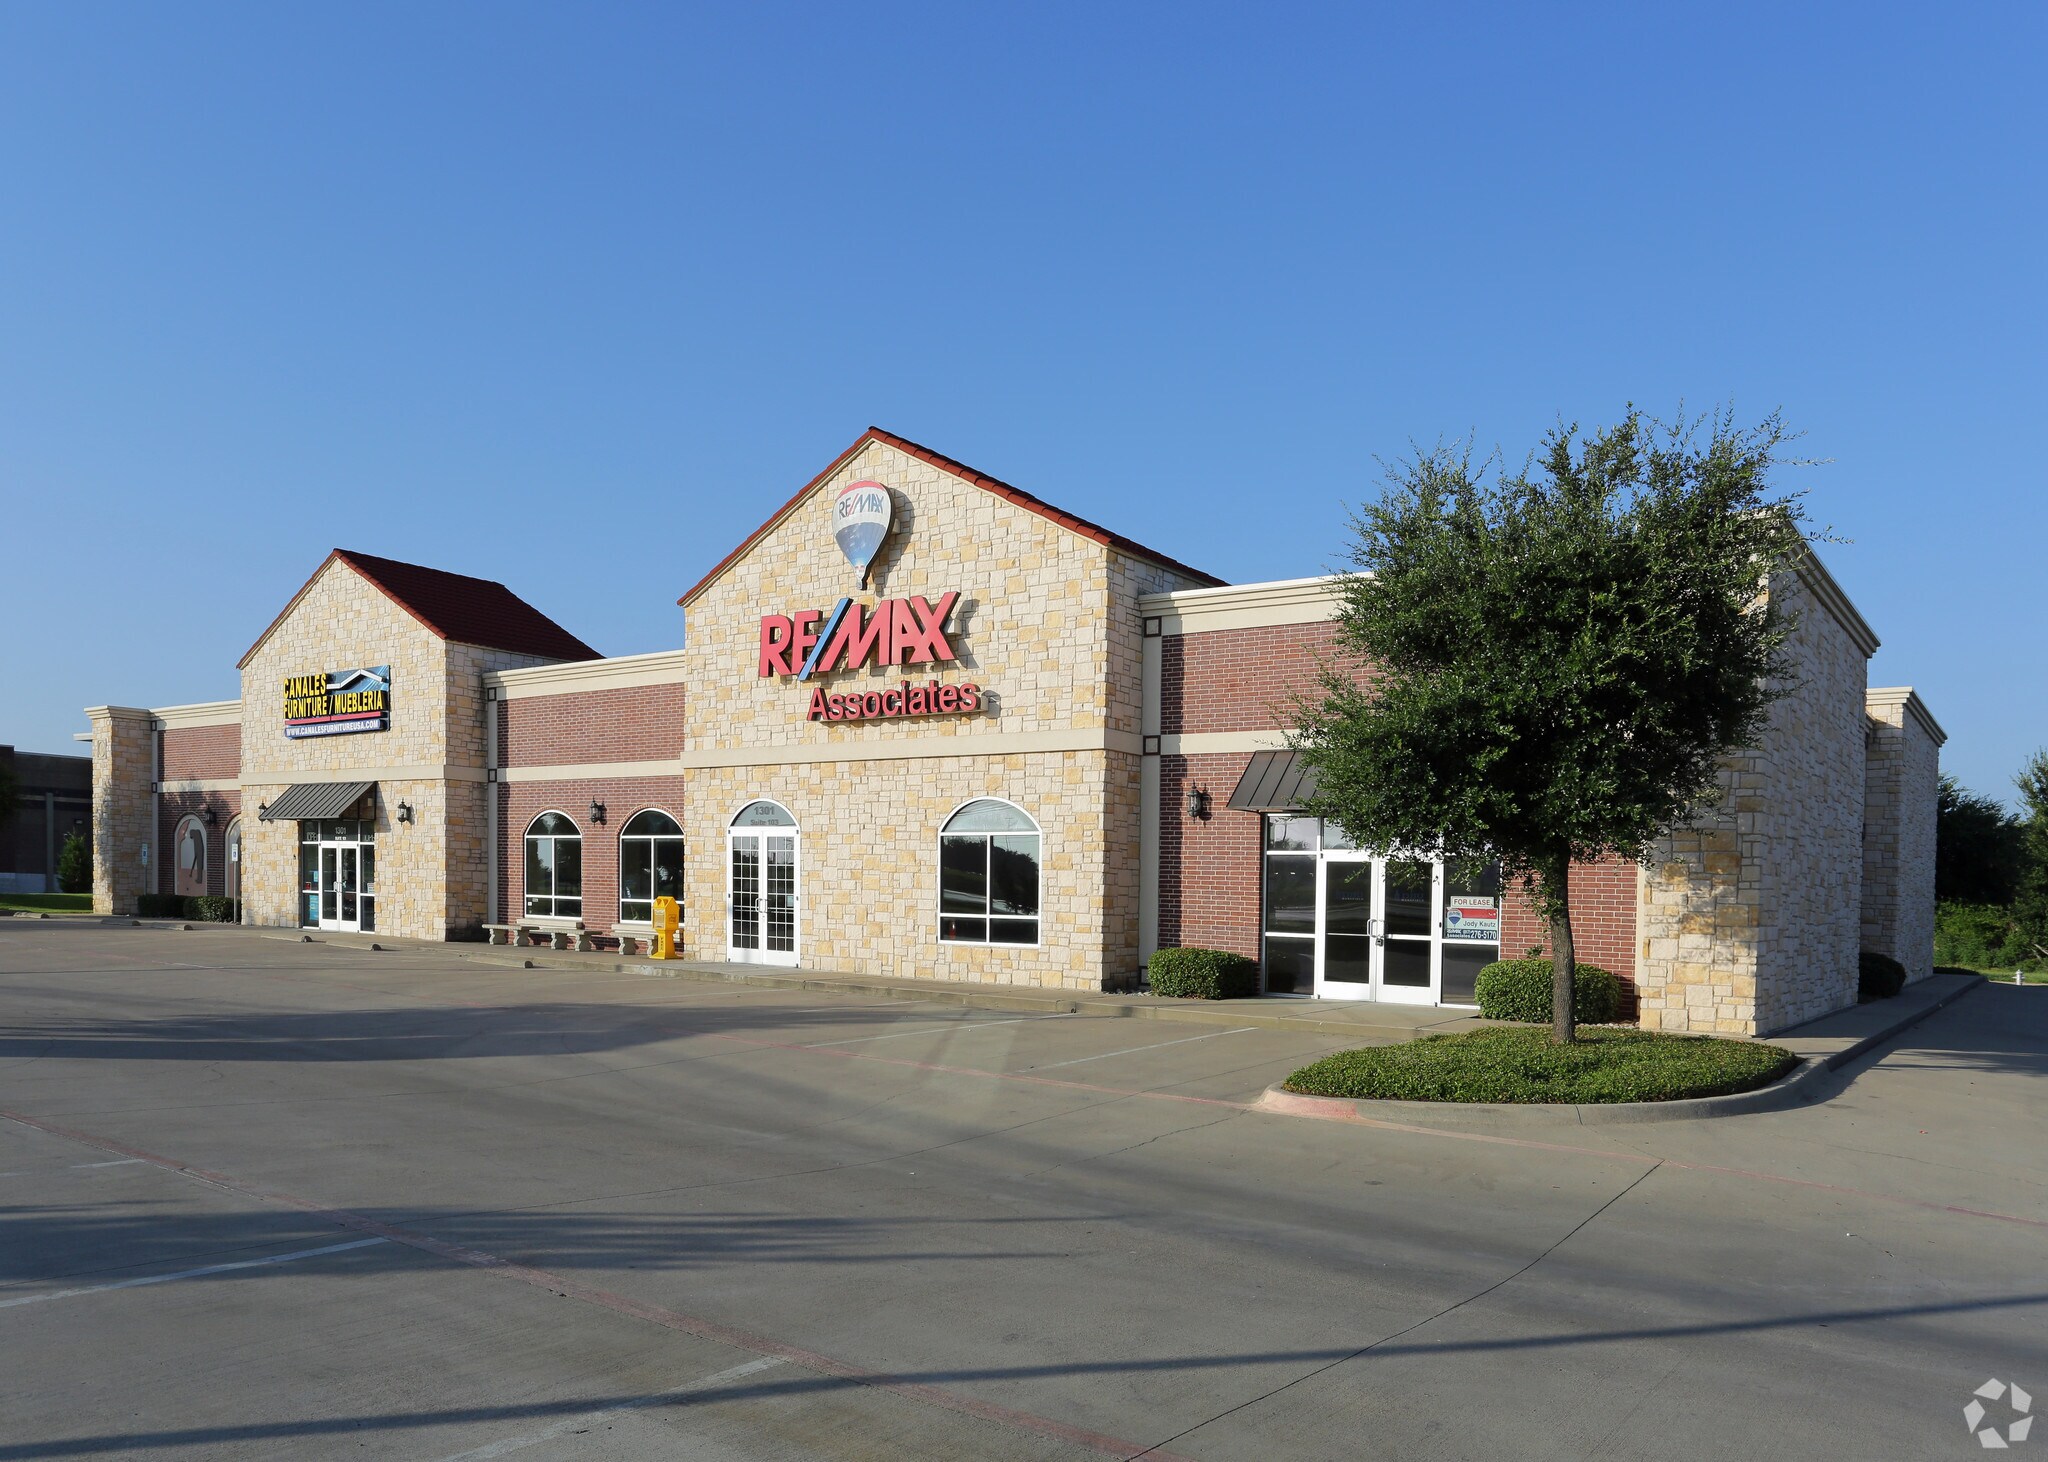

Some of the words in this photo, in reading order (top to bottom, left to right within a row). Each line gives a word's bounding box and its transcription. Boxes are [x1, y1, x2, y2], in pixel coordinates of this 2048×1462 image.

[839, 493, 884, 520] RE/MAX
[760, 591, 960, 681] RE/MAX
[284, 673, 327, 699] CANALES
[284, 695, 327, 720] FURNITURE
[335, 690, 383, 715] MUEBLERIA
[807, 680, 979, 721] Associates
[286, 719, 378, 737] WWW.CANALESFURNITUREUSA.COM
[754, 806, 775, 815] 1301
[1471, 930, 1497, 939] 276-5170
